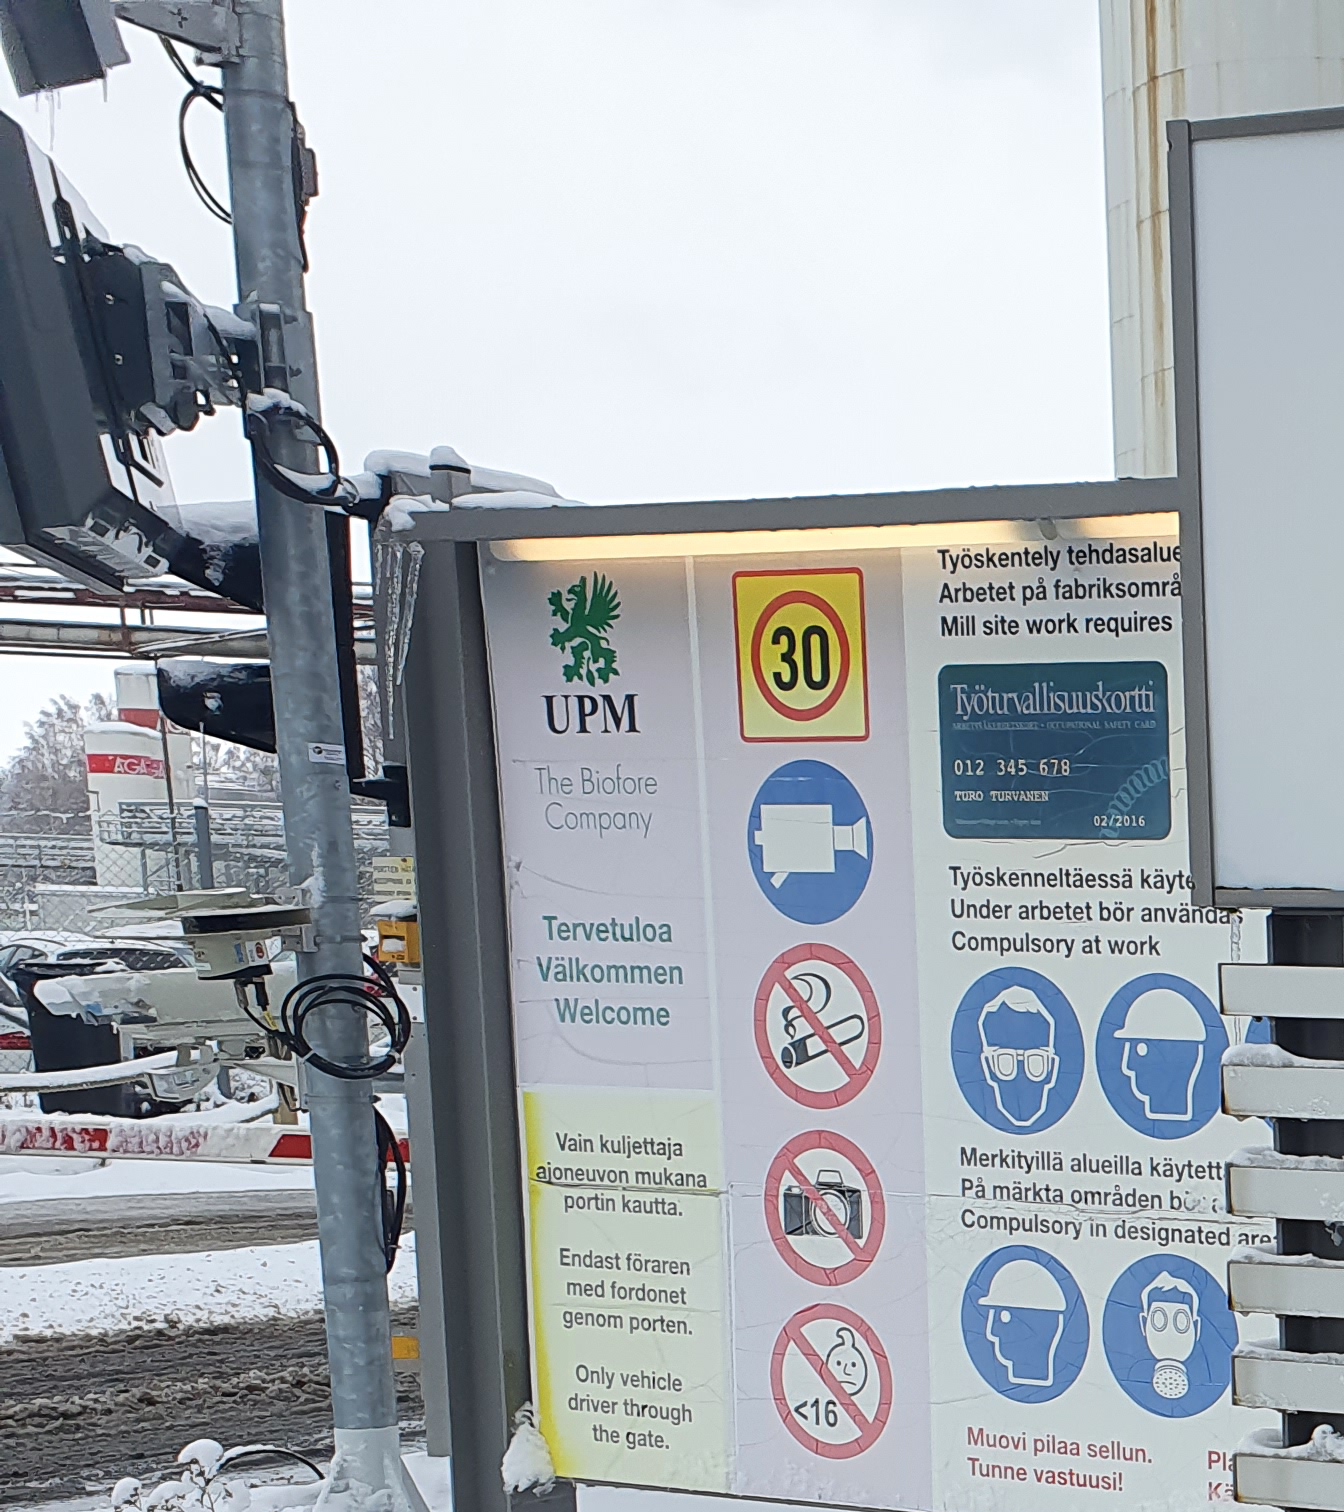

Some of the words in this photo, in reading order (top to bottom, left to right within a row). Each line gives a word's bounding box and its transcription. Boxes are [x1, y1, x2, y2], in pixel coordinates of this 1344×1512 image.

[938, 545, 1061, 574] Työskentely
[939, 582, 1016, 603] Arbetet
[1022, 577, 1047, 606] på
[941, 615, 976, 637] Mill
[983, 614, 1019, 635] site
[1026, 613, 1078, 634] work
[1085, 612, 1172, 637] requires
[771, 625, 830, 691] 30
[541, 693, 641, 734] UPM
[951, 681, 1155, 720] Työturvallisuuskortti
[1105, 721, 1131, 729] SAFETY
[534, 767, 573, 794] The
[580, 764, 657, 795] Biofore
[955, 760, 984, 776] 012
[997, 760, 1027, 776] 345
[1039, 759, 1070, 776] 678
[991, 791, 1049, 801] TURVANEN
[544, 803, 653, 839] Company
[1094, 816, 1145, 826] 02/2016
[949, 866, 1134, 892] Työskenneltäessä
[951, 899, 1010, 920] Under
[1019, 900, 1093, 922] arbetet
[1099, 901, 1134, 922] bör
[542, 916, 672, 943] Tervetuloa
[952, 931, 1075, 957] Compulsory
[1081, 935, 1101, 956] at
[1108, 933, 1161, 957] work
[536, 957, 683, 985] Välkommen
[555, 998, 670, 1026] Welcome
[555, 1132, 594, 1154] Vain
[600, 1135, 683, 1158] kuljettaja
[536, 1163, 629, 1185] ajoneuvon
[635, 1168, 707, 1188] mukana
[960, 1147, 1064, 1173] Merkityillä
[1070, 1153, 1143, 1177] alueilla
[1149, 1158, 1225, 1186] käytett
[564, 1193, 616, 1213] portin
[621, 1195, 683, 1216] kautta.
[961, 1178, 986, 1199] På
[992, 1181, 1063, 1205] märkta
[1071, 1185, 1163, 1211] områden
[961, 1210, 1082, 1240] Compulsory
[1090, 1217, 1107, 1239] in
[1115, 1220, 1230, 1247] designated
[1238, 1232, 1277, 1245] are
[559, 1248, 621, 1271] Endast
[626, 1251, 690, 1275] föraren
[567, 1279, 604, 1298] med
[610, 1281, 686, 1305] fordonet
[563, 1310, 623, 1330] genom
[629, 1312, 693, 1335] porten.
[576, 1364, 616, 1387] Only
[620, 1369, 682, 1392] vehicle
[568, 1394, 618, 1416] driver
[623, 1399, 692, 1425] through
[592, 1424, 619, 1444] the
[626, 1431, 670, 1450] gate.
[967, 1426, 1027, 1452] Muovi
[1034, 1431, 1080, 1459] pilaa
[1088, 1439, 1153, 1464] sellun.
[968, 1457, 1027, 1483] Tunne
[1035, 1461, 1124, 1492] vastuusi!
